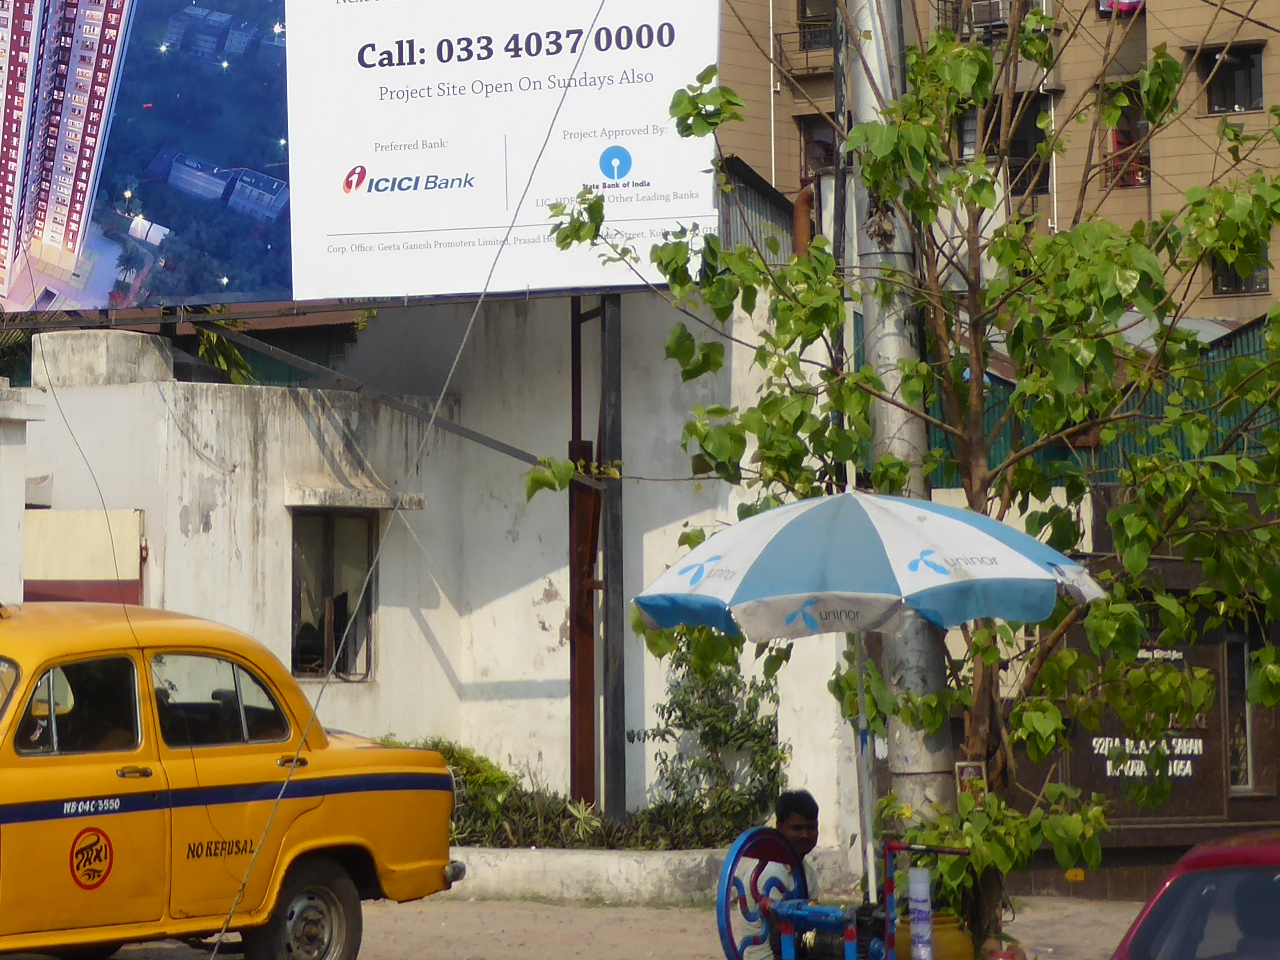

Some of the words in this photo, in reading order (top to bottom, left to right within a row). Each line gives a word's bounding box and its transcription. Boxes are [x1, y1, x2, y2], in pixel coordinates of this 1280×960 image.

[358, 39, 425, 68] Call:
[436, 35, 493, 62] 033
[504, 29, 583, 58] 4037
[594, 22, 675, 52] 0000
[379, 83, 433, 102] Project
[437, 82, 466, 97] Site
[471, 79, 513, 98] Open
[518, 76, 542, 91] On
[547, 71, 614, 92] Sundays
[619, 70, 653, 85] Also
[563, 129, 597, 140] Project
[600, 126, 649, 139] Approved
[652, 125, 668, 136] By:
[374, 140, 418, 152] Preferred
[422, 139, 448, 150] Bank:
[367, 176, 420, 192] ICICI
[424, 173, 475, 190] Bank
[636, 193, 670, 202] Leading
[673, 190, 699, 199] Banks
[328, 245, 348, 254] Corp.
[378, 243, 400, 251] Geeta
[403, 242, 432, 250] Ganesh
[434, 240, 475, 250] Promoters
[513, 234, 541, 244] Prasad
[944, 555, 998, 566] uninor
[820, 610, 860, 621] uninor
[75, 833, 108, 871] TAXI
[187, 842, 203, 859] NO
